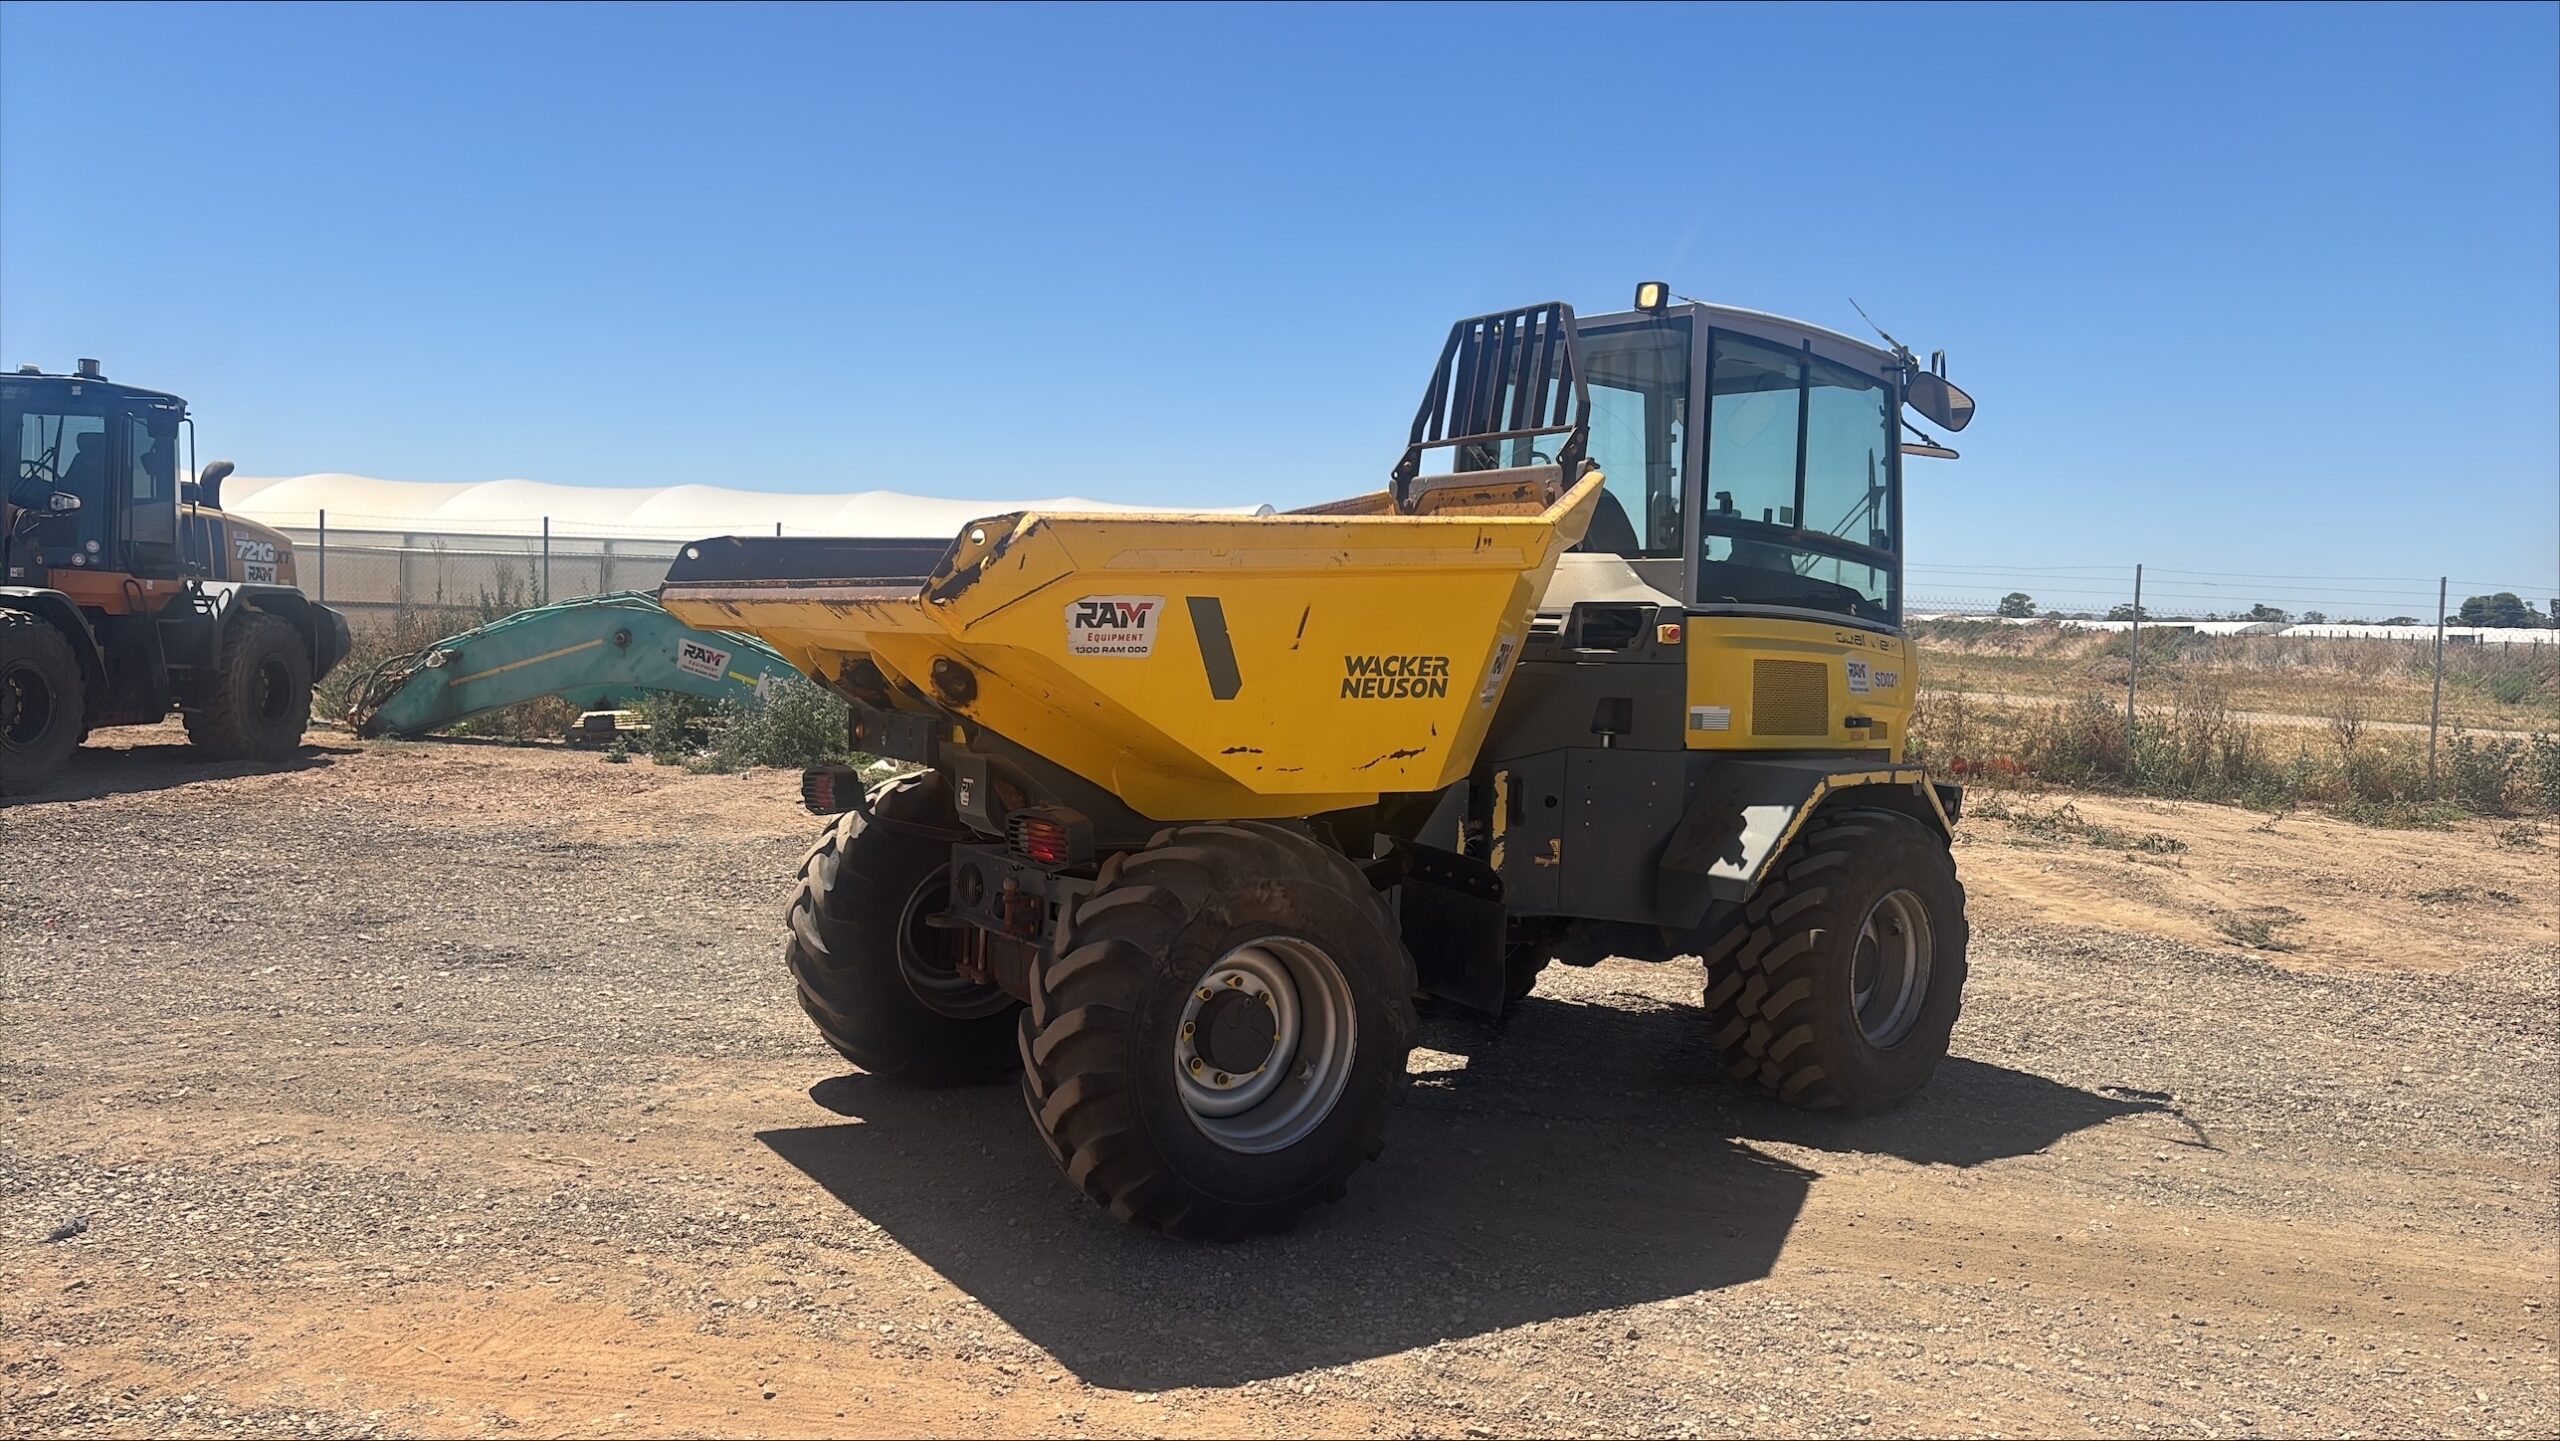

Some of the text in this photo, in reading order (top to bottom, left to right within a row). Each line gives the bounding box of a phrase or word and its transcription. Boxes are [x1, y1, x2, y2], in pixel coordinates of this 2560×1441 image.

[235, 540, 276, 562] 721G
[248, 566, 273, 581] RAM
[1075, 602, 1154, 628] RAM
[1087, 632, 1144, 643] EQUIPMENT
[684, 644, 725, 666] RAM
[1075, 646, 1100, 654] 1300
[1344, 655, 1450, 677] WACKER
[1340, 678, 1449, 699] NEUSON
[1875, 672, 1897, 688] SD021
